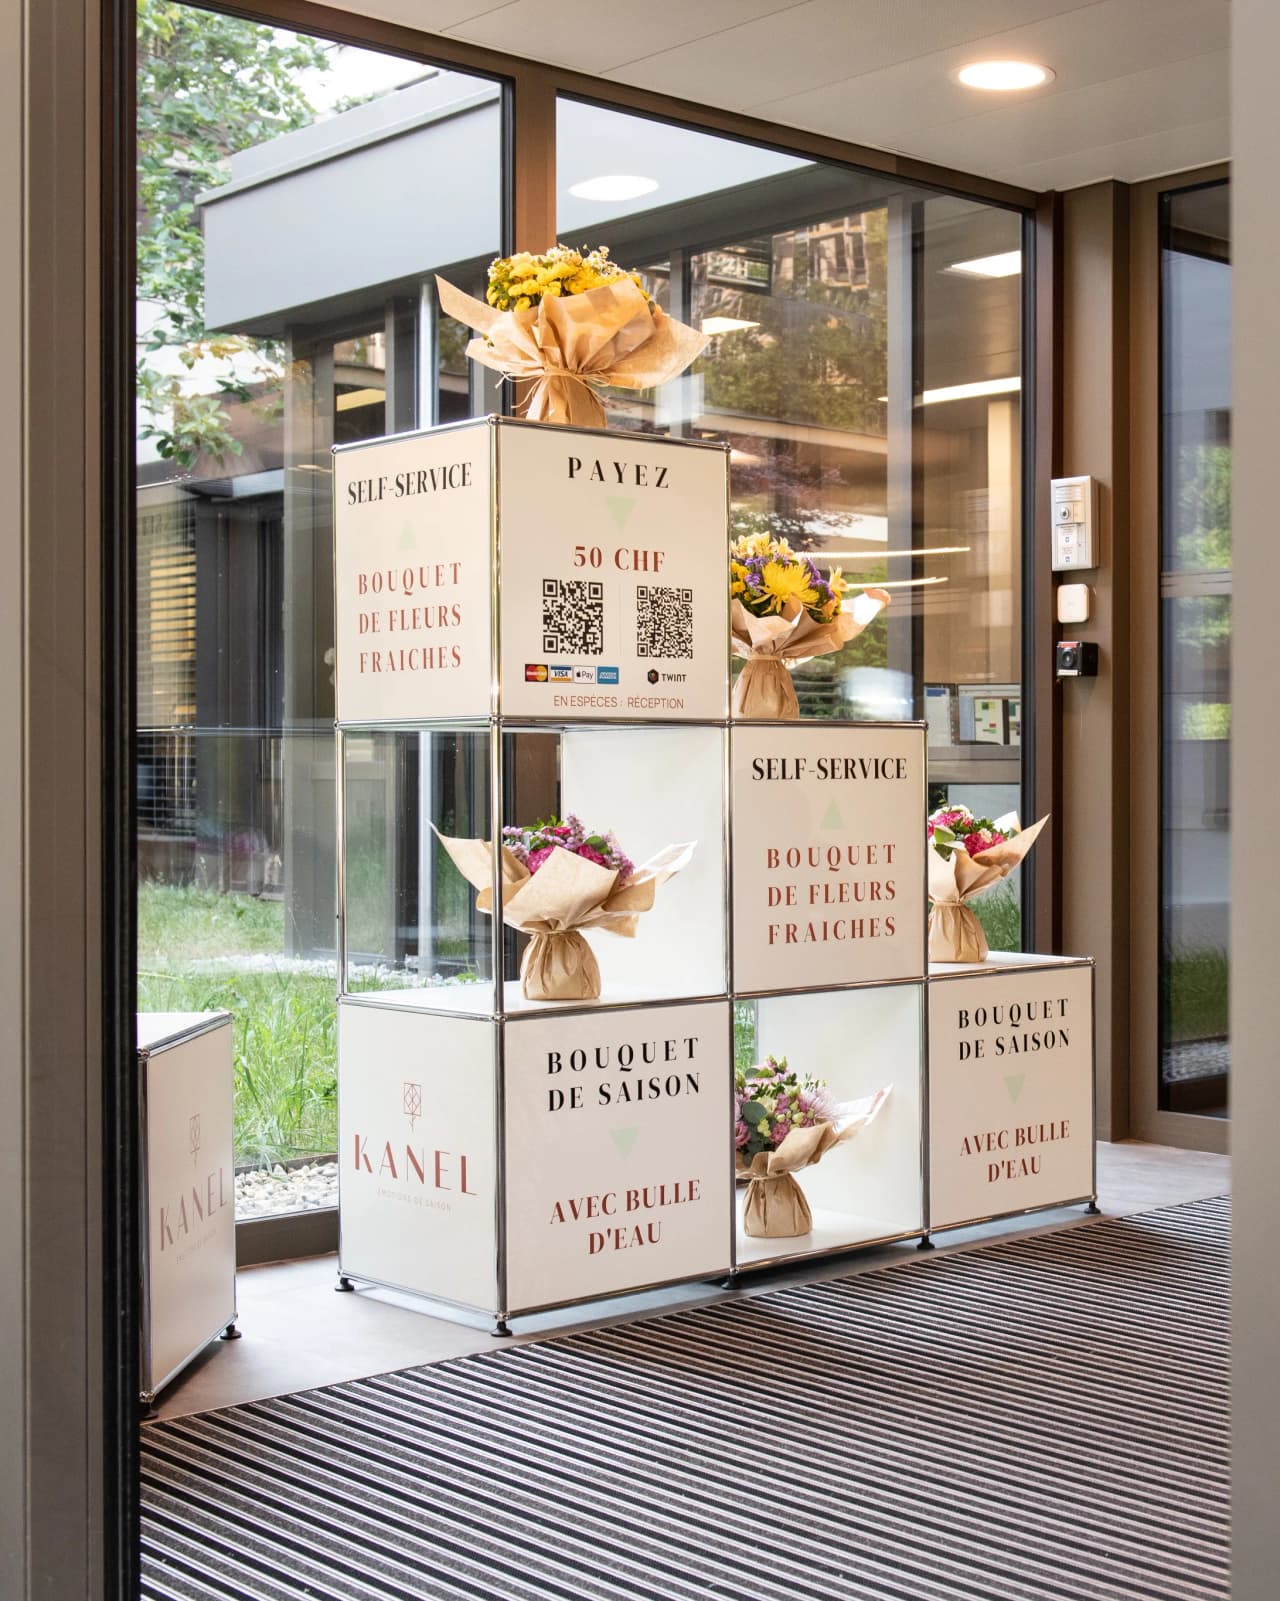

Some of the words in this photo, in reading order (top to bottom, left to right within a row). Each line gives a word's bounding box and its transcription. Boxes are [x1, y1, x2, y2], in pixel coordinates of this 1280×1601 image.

[347, 462, 472, 506] SELF-SERVICE
[567, 456, 669, 489] PAYEZ
[573, 545, 603, 569] 50
[614, 547, 666, 573] CHF
[358, 561, 462, 596] BOUQUET
[359, 611, 381, 635] DE
[389, 603, 462, 632] FLEURS
[359, 645, 462, 674] FRAICHES
[554, 670, 568, 678] VISA
[553, 695, 568, 707] EN
[751, 756, 908, 781] SELF-SERVICE
[767, 843, 897, 872] BOUQUET
[767, 885, 798, 907] DE
[809, 880, 897, 905] FLEURS
[768, 916, 897, 945] FRAICHES
[958, 998, 1070, 1030] BOUQUET
[547, 1036, 700, 1075] BOUQUET
[958, 1038, 985, 1061] DE
[995, 1028, 1070, 1056] SAISON
[547, 1086, 584, 1112] DE
[597, 1073, 701, 1106] SAISON
[959, 1129, 1010, 1156] AVEC
[1014, 1119, 1070, 1147] BULLE
[354, 1134, 478, 1196] KANEL
[987, 1156, 1041, 1184] D'EAU
[160, 1167, 228, 1252] KANEL
[549, 1192, 617, 1225] AVEC
[625, 1178, 702, 1212] BULLE
[588, 1222, 663, 1256] D'EAU
